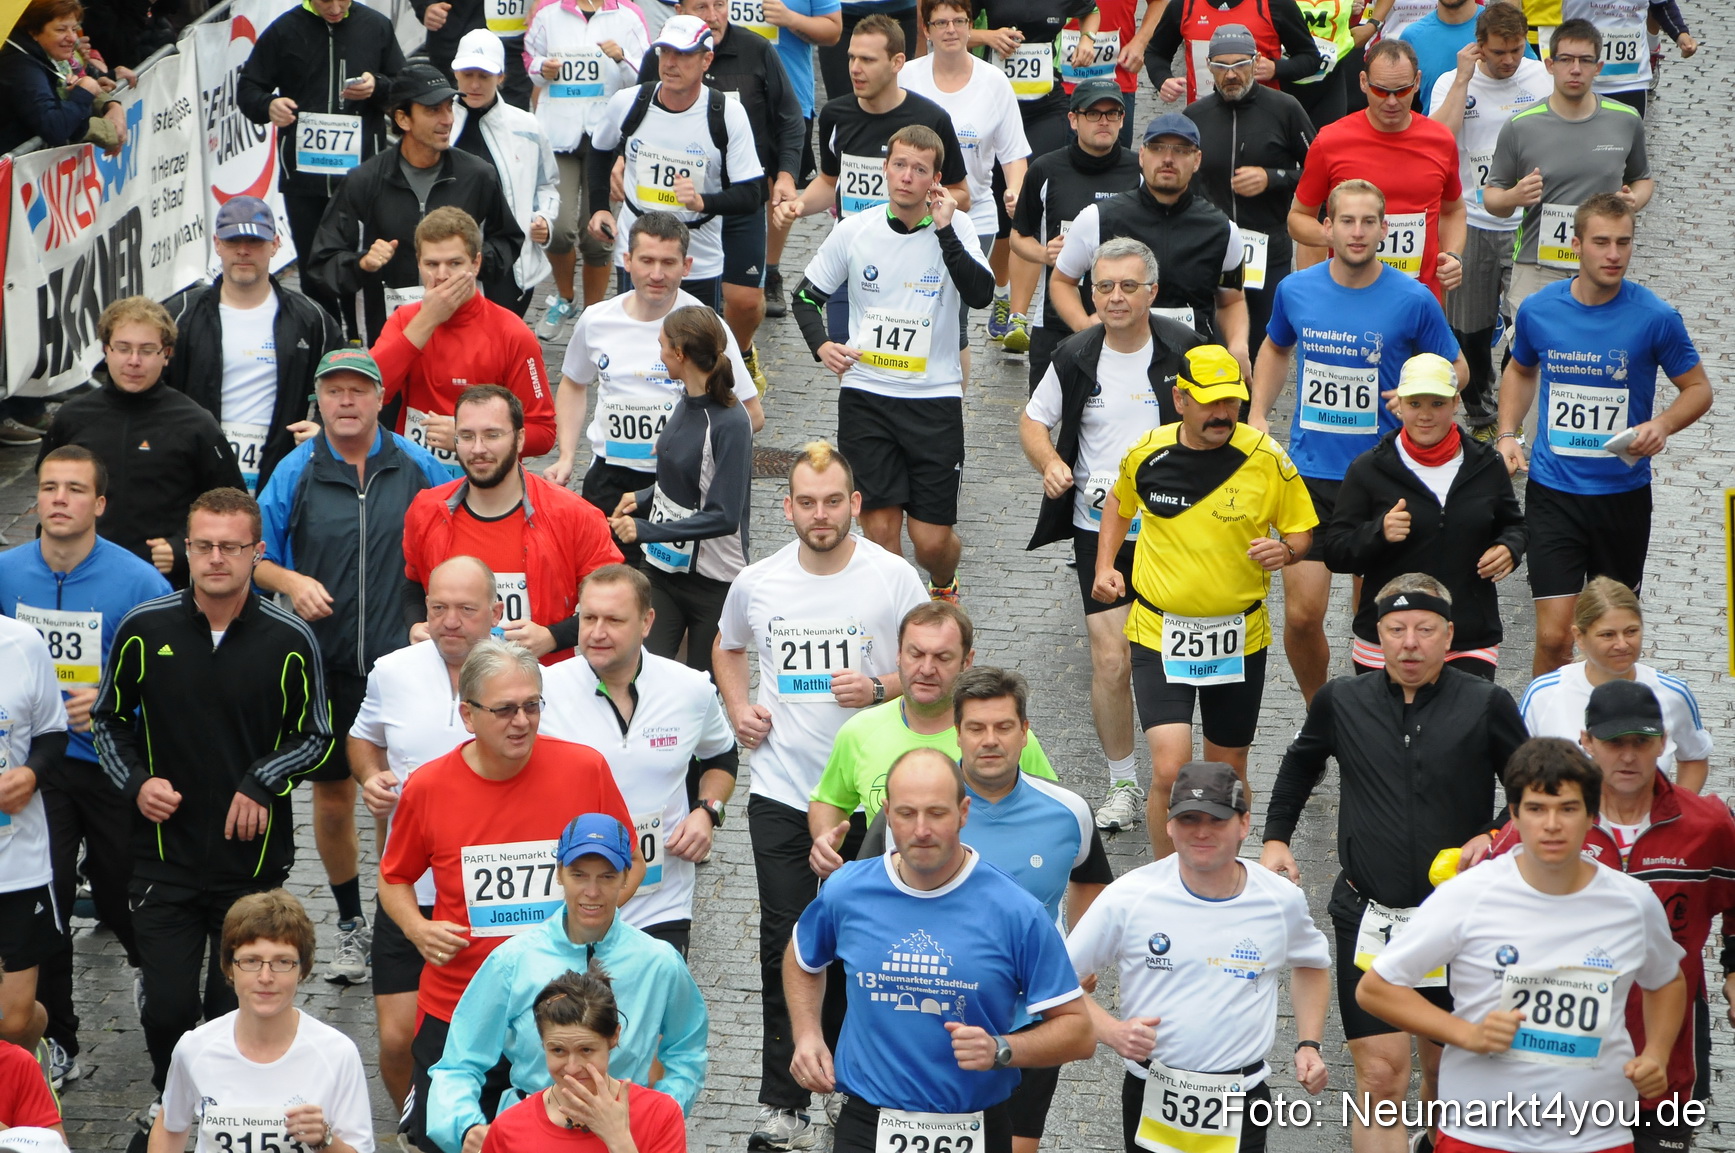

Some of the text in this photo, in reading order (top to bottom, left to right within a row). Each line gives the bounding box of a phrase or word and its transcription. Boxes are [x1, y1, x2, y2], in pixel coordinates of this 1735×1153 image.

[731, 2, 766, 22] 553
[1067, 45, 1114, 63] 278
[1004, 58, 1040, 78] 529
[1073, 68, 1103, 78] Stephan
[566, 87, 581, 95] Eva
[303, 128, 354, 151] 2677
[310, 157, 344, 166] andreas
[639, 151, 694, 166] PARTL Neumarkt
[842, 161, 860, 169] PARTL
[1470, 156, 1491, 164] PARTL
[658, 192, 675, 203] Udo
[1543, 210, 1566, 218] PARTL
[861, 281, 880, 289] PARTL
[863, 313, 919, 326] PARTL Neumarkt
[872, 325, 917, 352] 147
[1302, 327, 1358, 344] Kirwaläufer
[1302, 341, 1358, 357] Pettenhofen
[1547, 349, 1602, 363] Kirwaläufer
[872, 354, 910, 369] Thomas
[1304, 367, 1364, 383] PARTL Neumarkt
[1547, 363, 1603, 376] Pettenhofen
[526, 357, 543, 399] SIEMENS
[1308, 380, 1370, 409] 2616
[1551, 389, 1614, 403] PARTL Neumarkt
[1318, 412, 1358, 425] Michael
[1555, 401, 1620, 431] 2617
[608, 413, 667, 440] 3064
[1568, 435, 1600, 448] Jakob
[1089, 477, 1112, 485] PARTL
[1149, 491, 1192, 507] Heinz L.
[1211, 510, 1247, 523] Burgthann
[43, 617, 85, 628] Neumarkt
[1164, 618, 1231, 632] PARTL Neumarkt
[803, 628, 844, 636] Neumarkt
[36, 627, 82, 661] 83
[1170, 629, 1238, 657] 2510
[781, 640, 849, 670] 2111
[1189, 664, 1218, 676] Heinz
[464, 850, 547, 865] PARTL Neumarkt
[1642, 856, 1688, 866] Manfred A.
[474, 864, 556, 901] 2877
[489, 907, 545, 924] Joachim
[1145, 956, 1173, 966] PARTL
[1146, 964, 1173, 972] Neumarkt
[856, 972, 979, 991] 13. Neumarkter Stadtlauf
[1506, 974, 1540, 985] PARTL
[1542, 977, 1593, 991] Neumarkt
[1510, 989, 1599, 1032] 2880
[1521, 1033, 1576, 1054] Thomas
[1149, 1068, 1227, 1093] PARTL Neumarkt
[1161, 1089, 1223, 1130] 532
[206, 1116, 240, 1127] PARTL
[881, 1118, 967, 1131] PARTL Neumarkt
[889, 1134, 974, 1153] 2362
[1658, 1139, 1685, 1150] JAKO
